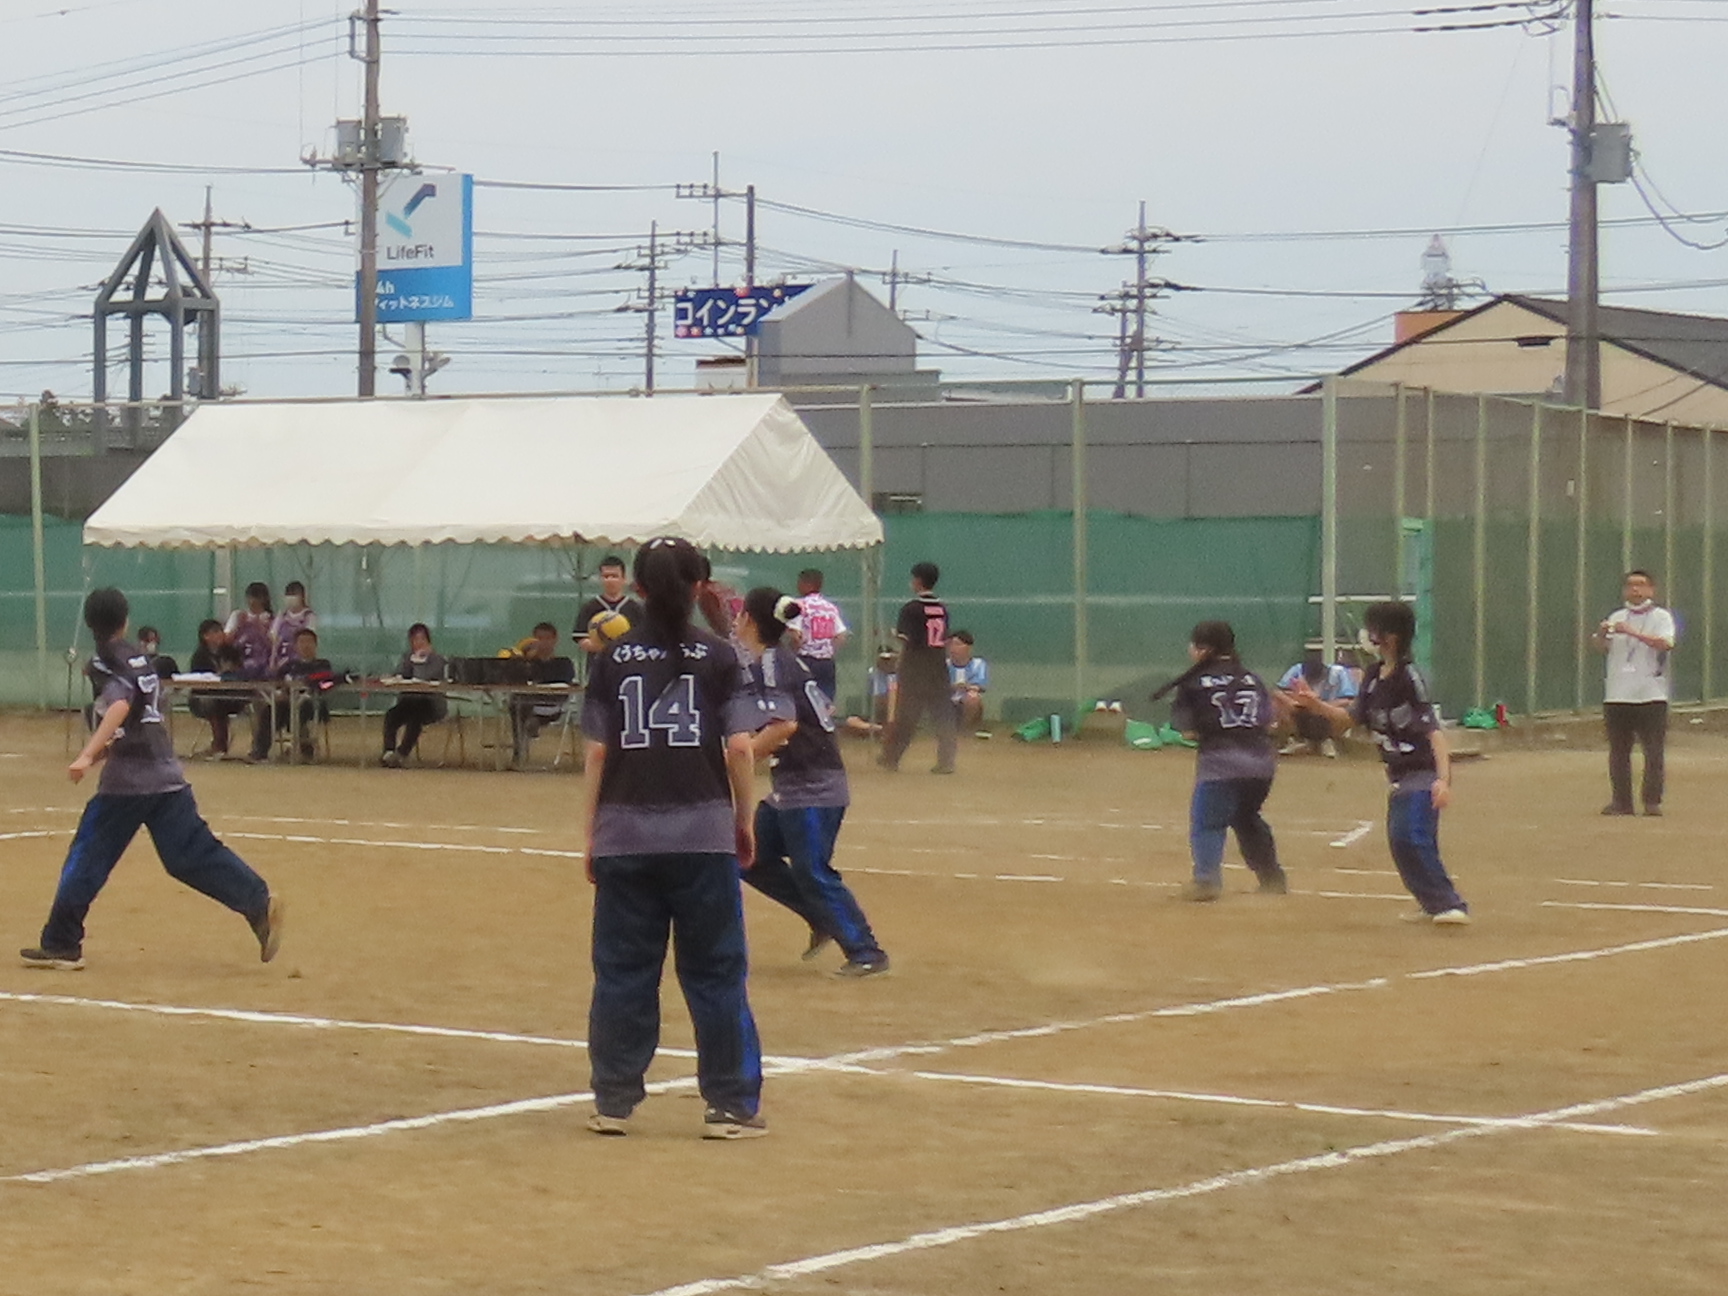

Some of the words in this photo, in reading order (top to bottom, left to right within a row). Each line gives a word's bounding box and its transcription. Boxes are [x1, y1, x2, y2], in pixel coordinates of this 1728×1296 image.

[387, 245, 435, 260] LifeFit
[375, 295, 455, 310] ィットネスジム
[618, 674, 700, 749] 14
